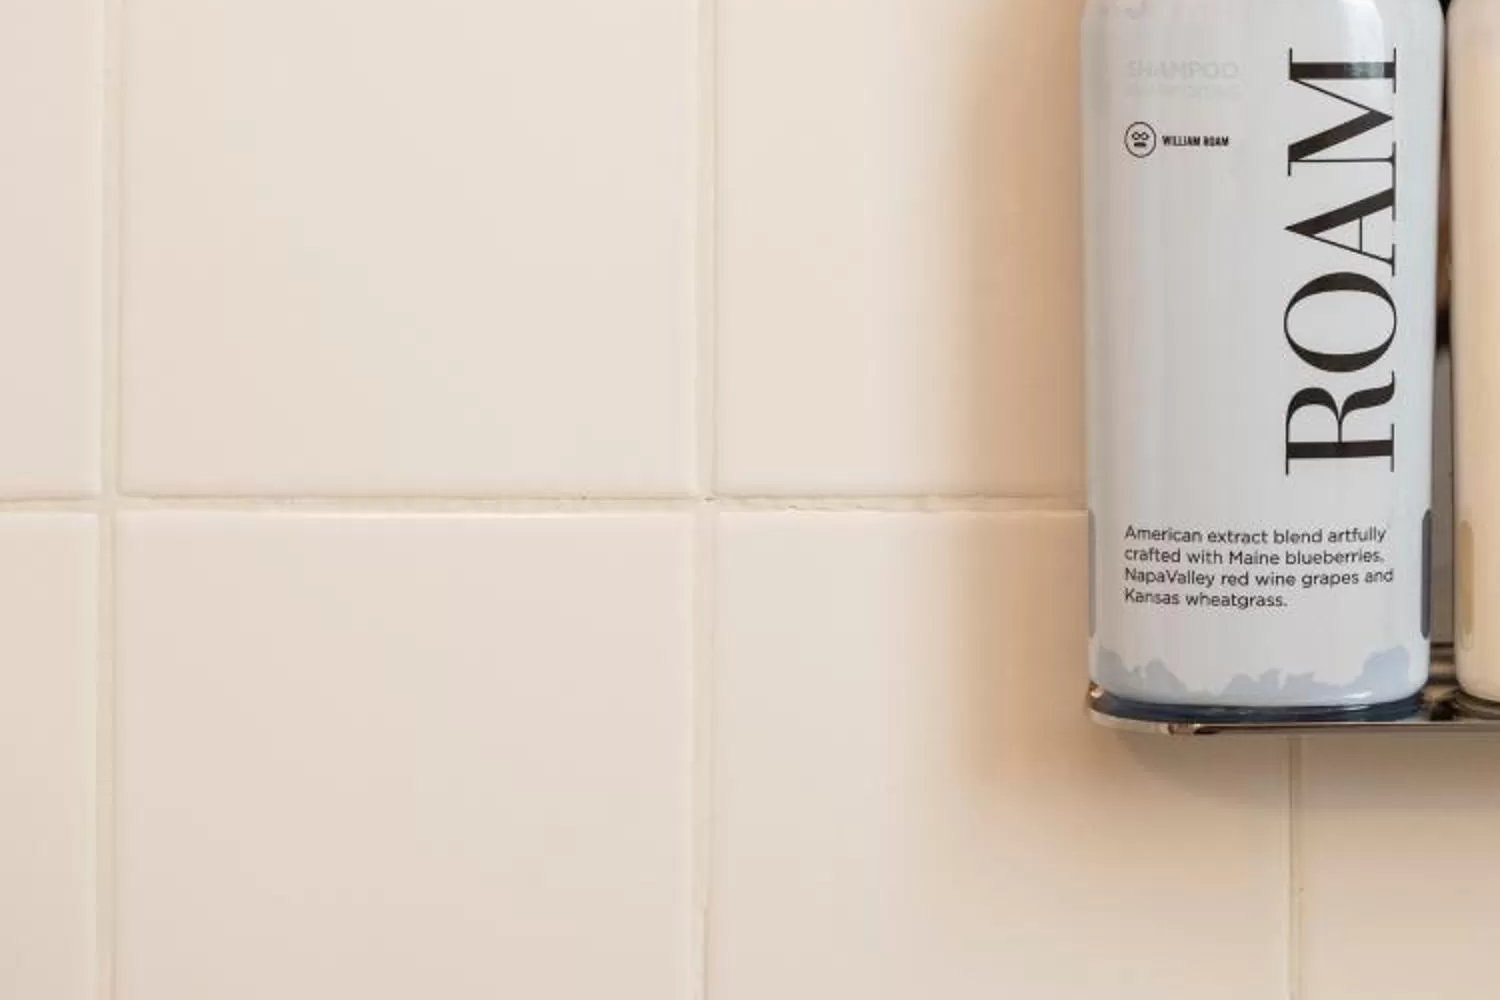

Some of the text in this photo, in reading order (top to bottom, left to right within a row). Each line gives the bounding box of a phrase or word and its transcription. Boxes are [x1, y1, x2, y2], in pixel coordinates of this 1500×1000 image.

[1162, 136, 1230, 147] WILLIAM ROAM
[1283, 47, 1397, 476] ROAM
[1124, 525, 1386, 544] American extract blend artfully
[1124, 548, 1180, 563] crafted
[1187, 550, 1222, 564] with
[1229, 552, 1280, 565] Maine
[1125, 568, 1393, 588] NapaValley red wine grapes and
[1124, 588, 1287, 610] Kansas wheatgrass.
